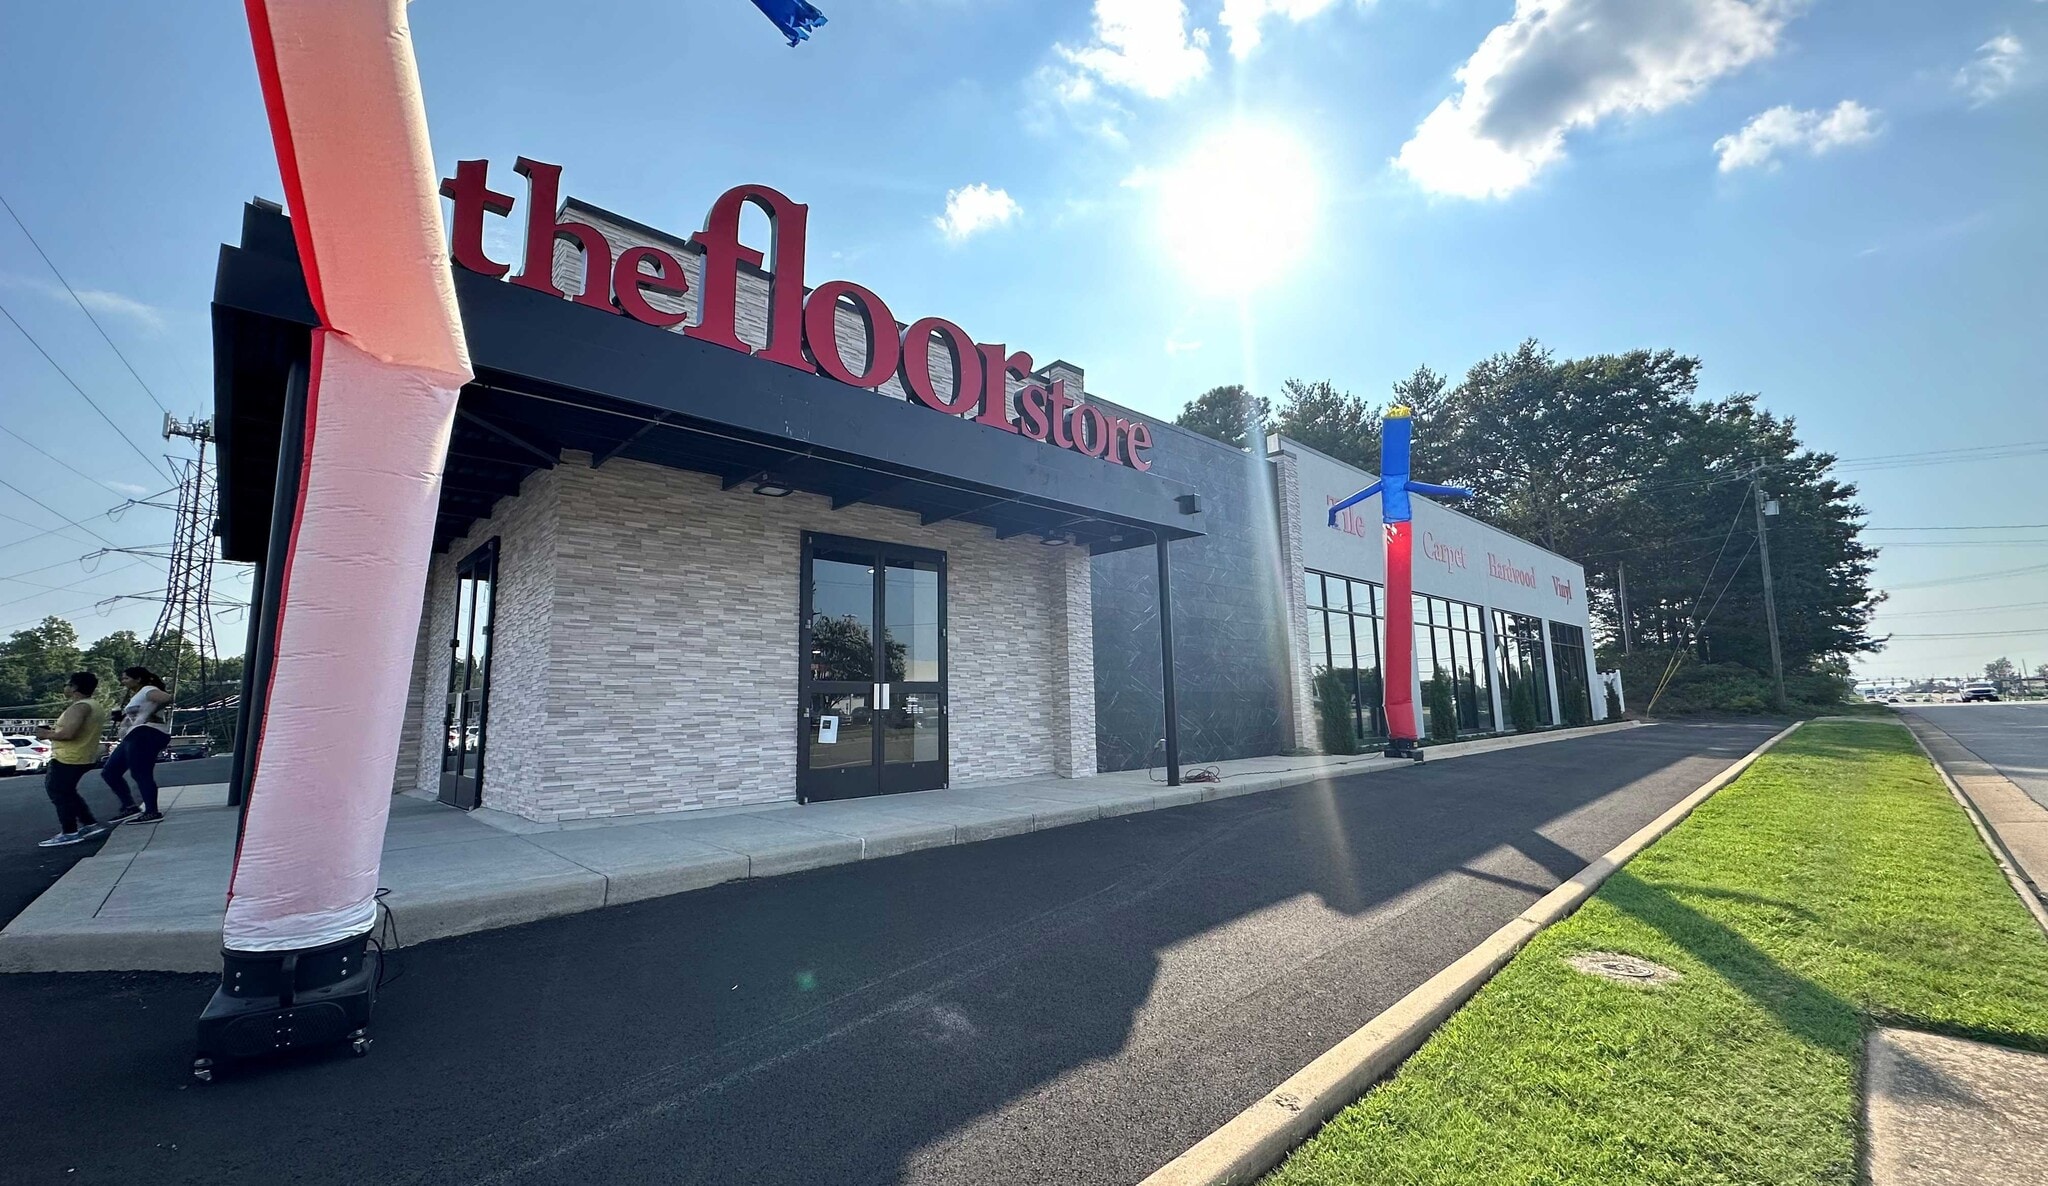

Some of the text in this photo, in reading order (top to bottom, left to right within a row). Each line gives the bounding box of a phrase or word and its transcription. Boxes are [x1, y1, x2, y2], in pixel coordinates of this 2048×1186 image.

[1422, 531, 1467, 574] Carpet
[1487, 552, 1536, 589] Hardwood
[1551, 575, 1572, 605] Vinyl
